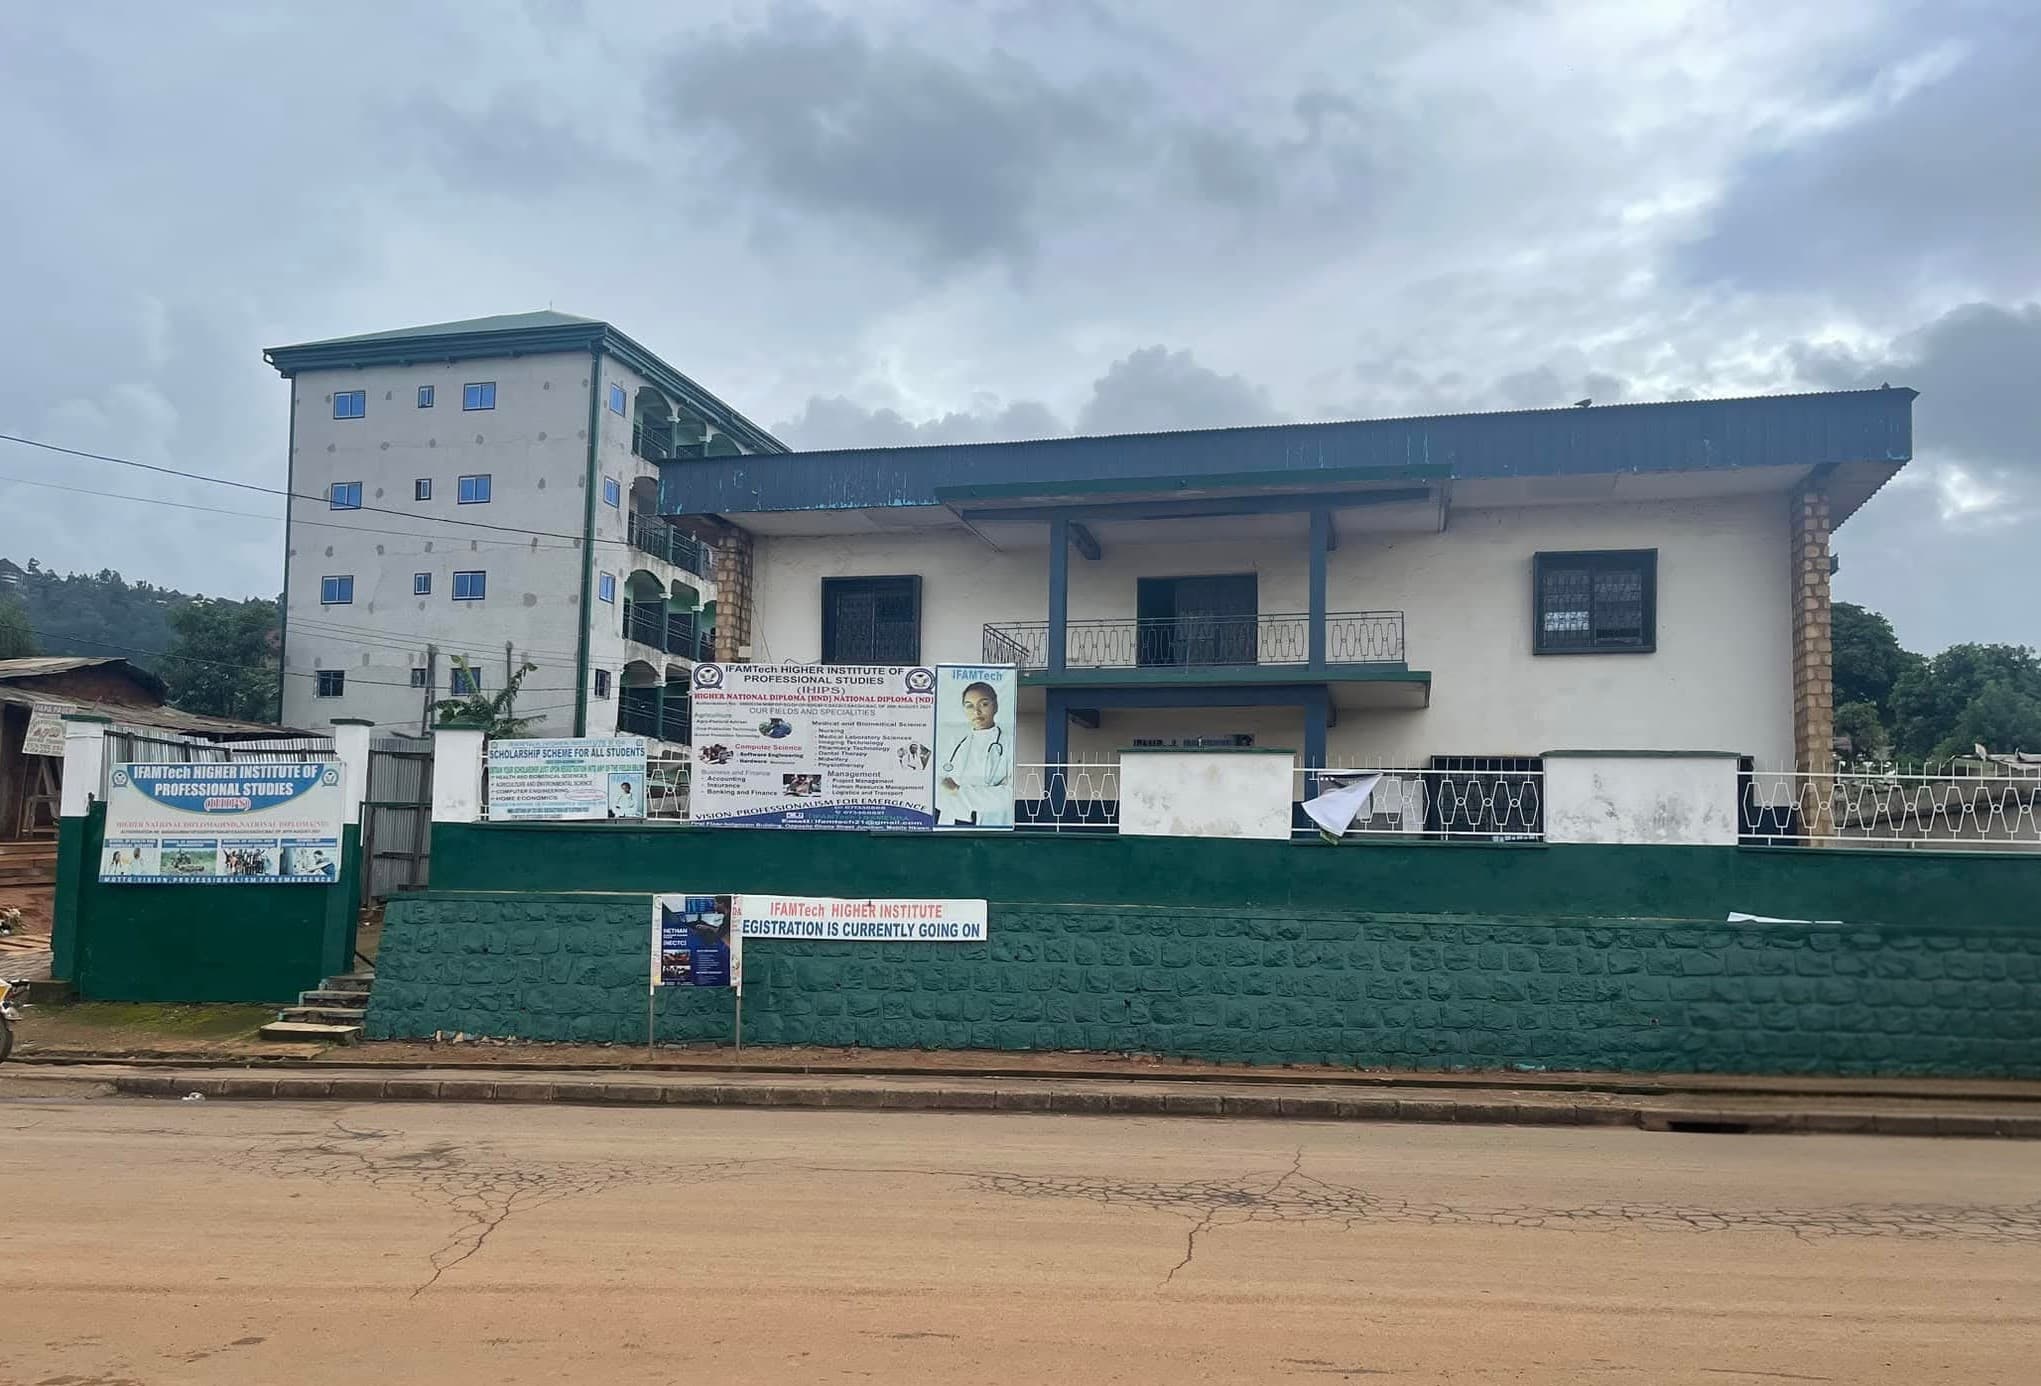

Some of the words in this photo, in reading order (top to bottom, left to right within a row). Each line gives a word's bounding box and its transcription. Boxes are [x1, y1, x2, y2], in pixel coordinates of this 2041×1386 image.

[725, 665, 778, 674] IFAMTech
[780, 666, 824, 674] HIGHER
[828, 667, 885, 675] INSTITUTE
[889, 668, 904, 676] OF
[952, 669, 1003, 680] IFAMTech
[744, 675, 832, 684] PROFESSIONAL
[836, 677, 884, 685] STUDIES
[797, 686, 846, 696] (IHIPS)
[770, 694, 805, 702] DIPLOMA
[820, 708, 876, 716] SPECIALITIES
[490, 748, 540, 759] SCHOLARSHIP
[542, 748, 573, 758] SCHEME
[574, 748, 590, 758] FOR
[591, 748, 604, 757] ALL
[606, 746, 645, 757] STUDENTS
[134, 766, 191, 779] IFAMTech
[193, 766, 237, 779] HIGHER
[240, 765, 300, 778] INSTITUTE
[303, 764, 318, 778] OF
[828, 770, 881, 778] Management
[154, 782, 240, 796] PROFESSIONAL
[243, 782, 294, 796] STUDIES
[736, 799, 834, 817] PROFESSIONALISM
[862, 798, 928, 810] EMERGENCE
[770, 902, 825, 917] IFAMTech
[831, 904, 876, 918] HIGHER
[880, 904, 942, 918] INSTITUTE
[742, 920, 824, 936] EGISTRATION
[828, 922, 839, 936] IS
[842, 922, 916, 937] CURRENTLY
[918, 923, 958, 938] GOING
[962, 923, 980, 938] ON
